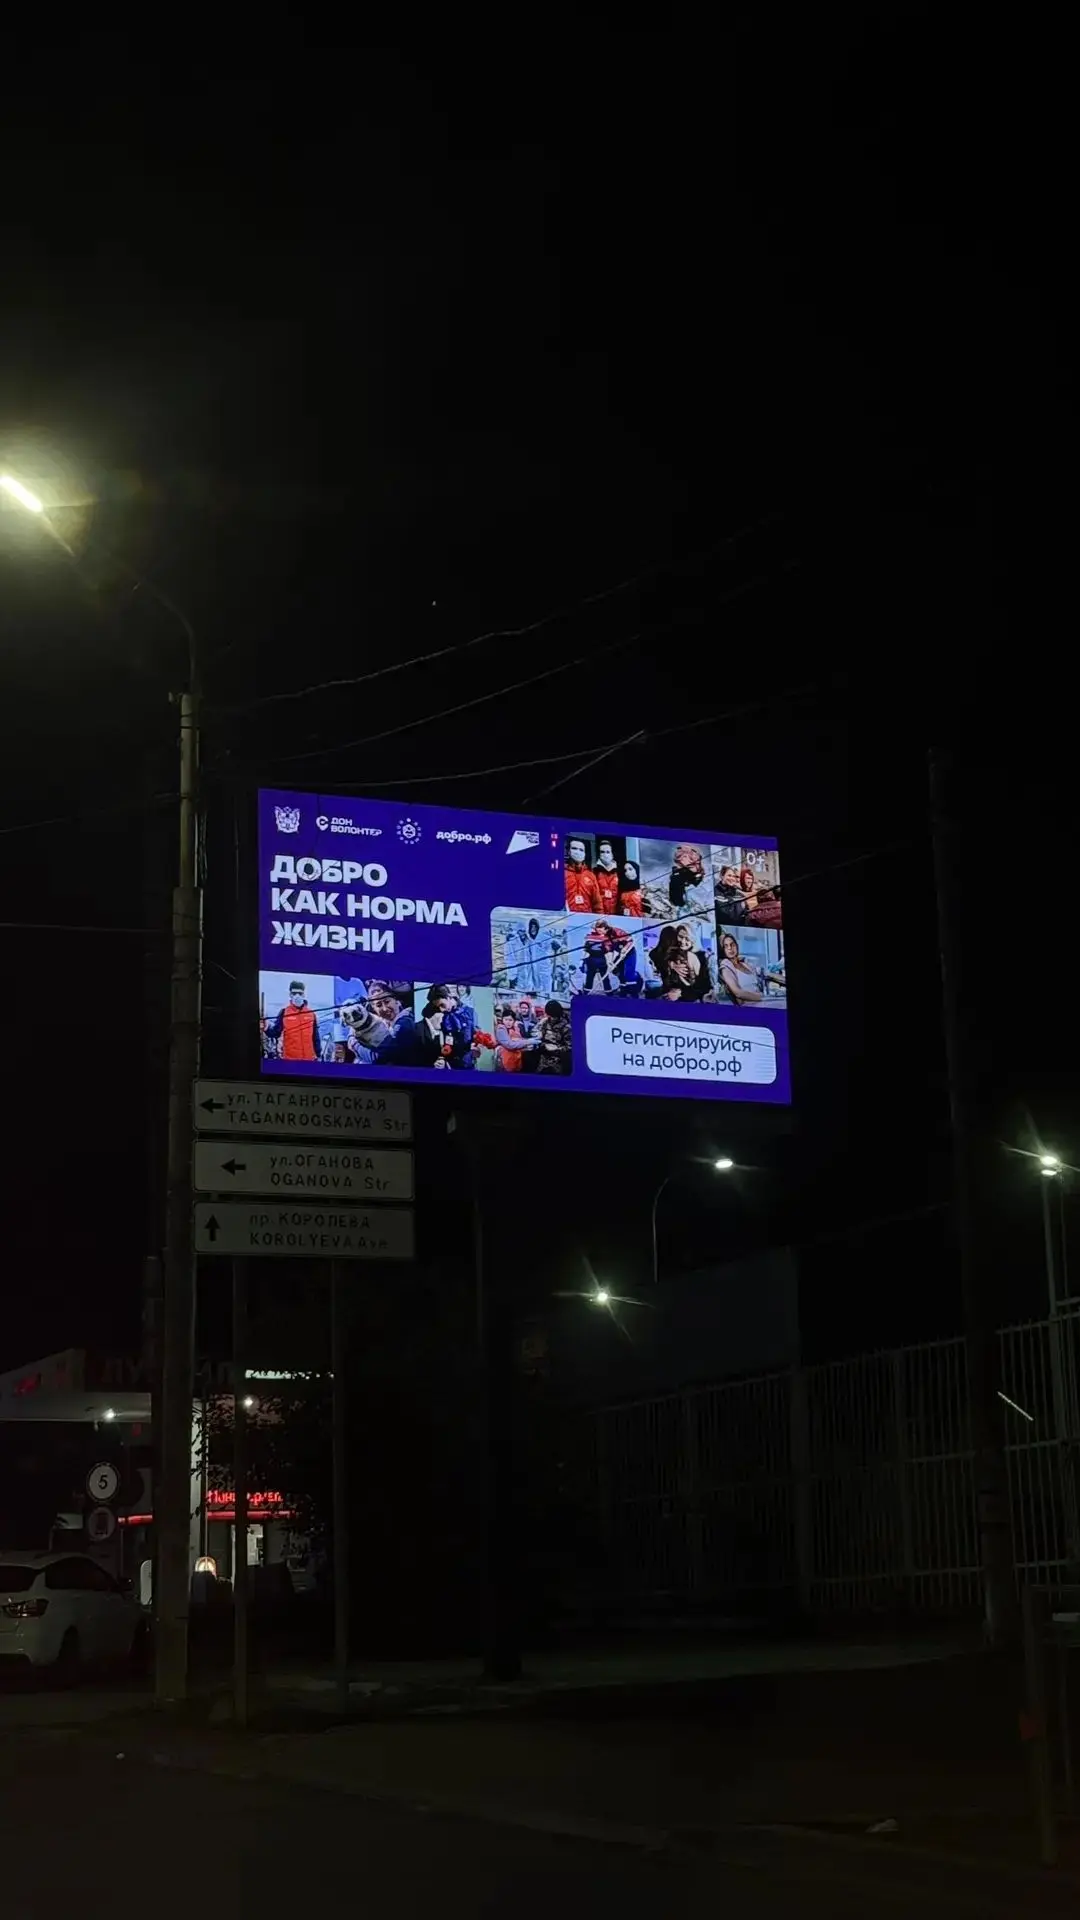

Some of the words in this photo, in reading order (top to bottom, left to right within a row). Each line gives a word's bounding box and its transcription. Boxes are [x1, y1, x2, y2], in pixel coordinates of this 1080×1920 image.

[330, 816, 353, 826] ДОН
[436, 830, 492, 844] добро.рф
[270, 854, 388, 887] ДОБРО
[271, 887, 341, 917] КАК
[347, 893, 469, 927] НОРМА
[271, 920, 395, 954] ЖИЗНИ
[610, 1027, 752, 1056] Регистрируйся
[623, 1052, 645, 1067] на
[649, 1053, 742, 1077] добро.рф
[228, 1110, 372, 1130] TAGANROGSKAYA
[383, 1117, 409, 1132] Str
[270, 1172, 353, 1188] OGANOVA
[364, 1177, 391, 1191] Str
[250, 1232, 356, 1249] KOROLYEVA
[98, 1474, 109, 1490] 5
